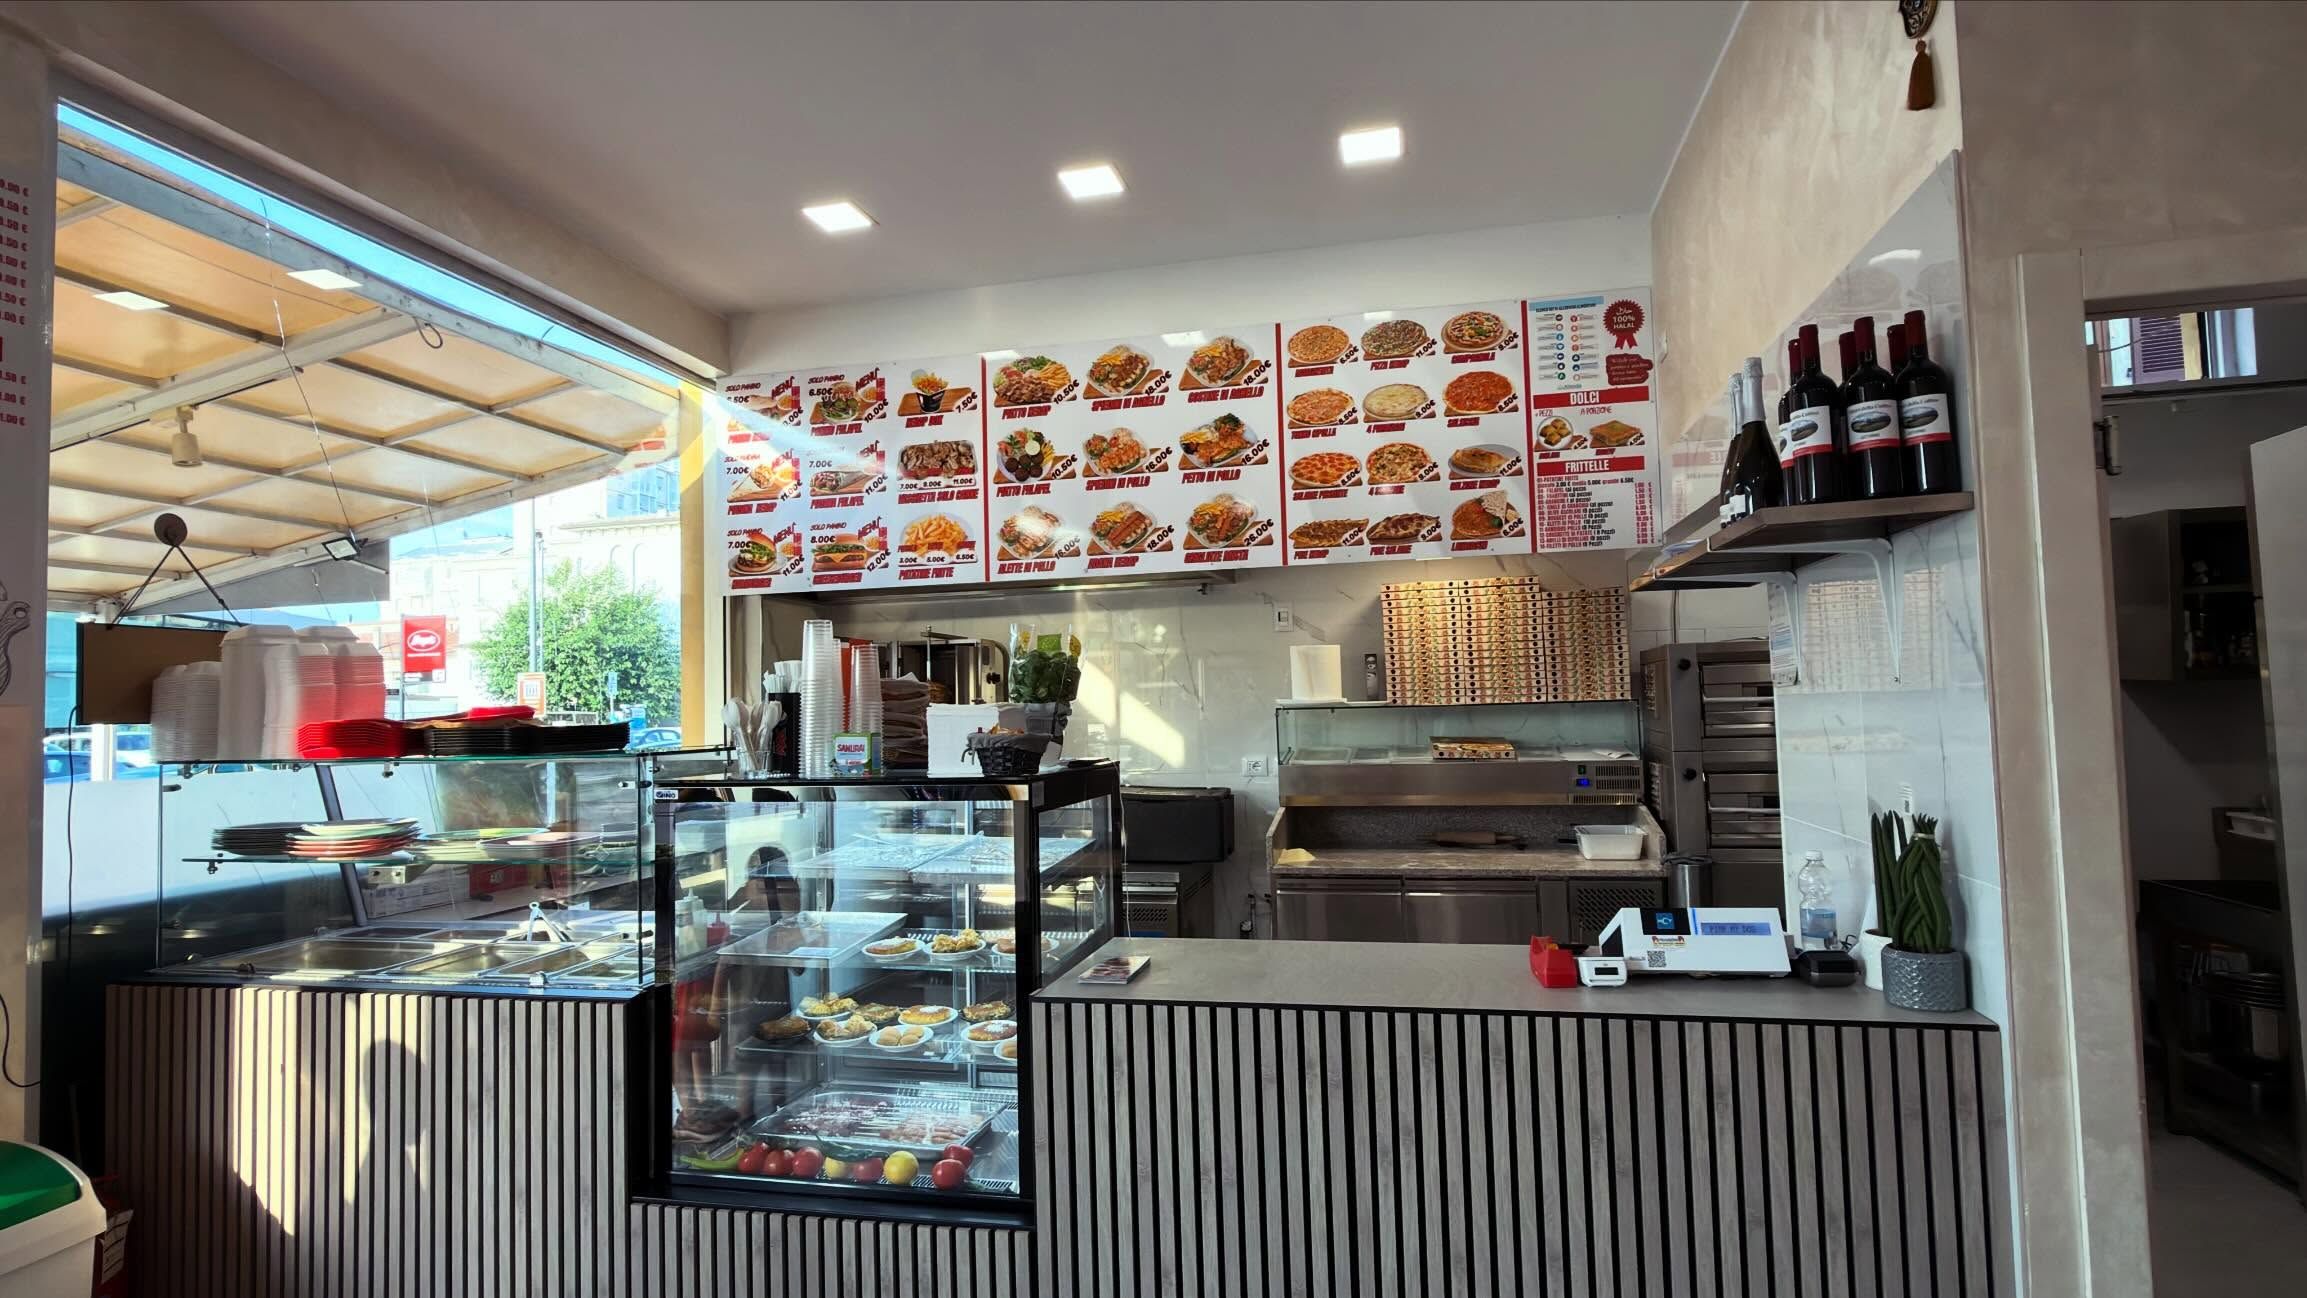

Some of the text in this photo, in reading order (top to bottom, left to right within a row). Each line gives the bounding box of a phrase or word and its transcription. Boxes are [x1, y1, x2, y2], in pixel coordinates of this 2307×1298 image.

[1613, 315, 1635, 323] 100%
[1416, 339, 1437, 358] 11.00€
[1498, 332, 1519, 351] 9.00€
[1340, 346, 1359, 364] 6.50€
[1244, 360, 1271, 386] 18.00€
[809, 388, 832, 396] 6.50€
[1054, 380, 1079, 404] 10.50€
[1145, 371, 1171, 396] 18.00€
[955, 391, 978, 413] 7.50€
[1570, 391, 1600, 405] DOLCI
[864, 399, 888, 423] 10.00€
[1416, 400, 1435, 418] 9.00€
[1366, 425, 1372, 433] 4
[1145, 447, 1172, 472] 16.00€
[1242, 439, 1269, 464] 16.00€
[1051, 454, 1077, 479] 10.50€
[1418, 462, 1438, 480] 9.00€
[1500, 456, 1521, 475] 11.00€
[1565, 460, 1609, 473] FRITTELLE
[865, 473, 888, 495] 11.00€
[1368, 487, 1374, 496] 4
[1147, 525, 1174, 550] 18.00€
[1243, 519, 1273, 546] 26.00€
[1343, 526, 1363, 545] 11.00€
[1421, 522, 1441, 540] 9.00€
[1054, 536, 1080, 560] 16.00€
[782, 554, 804, 576] 11.00€
[867, 549, 891, 572] 12.00€
